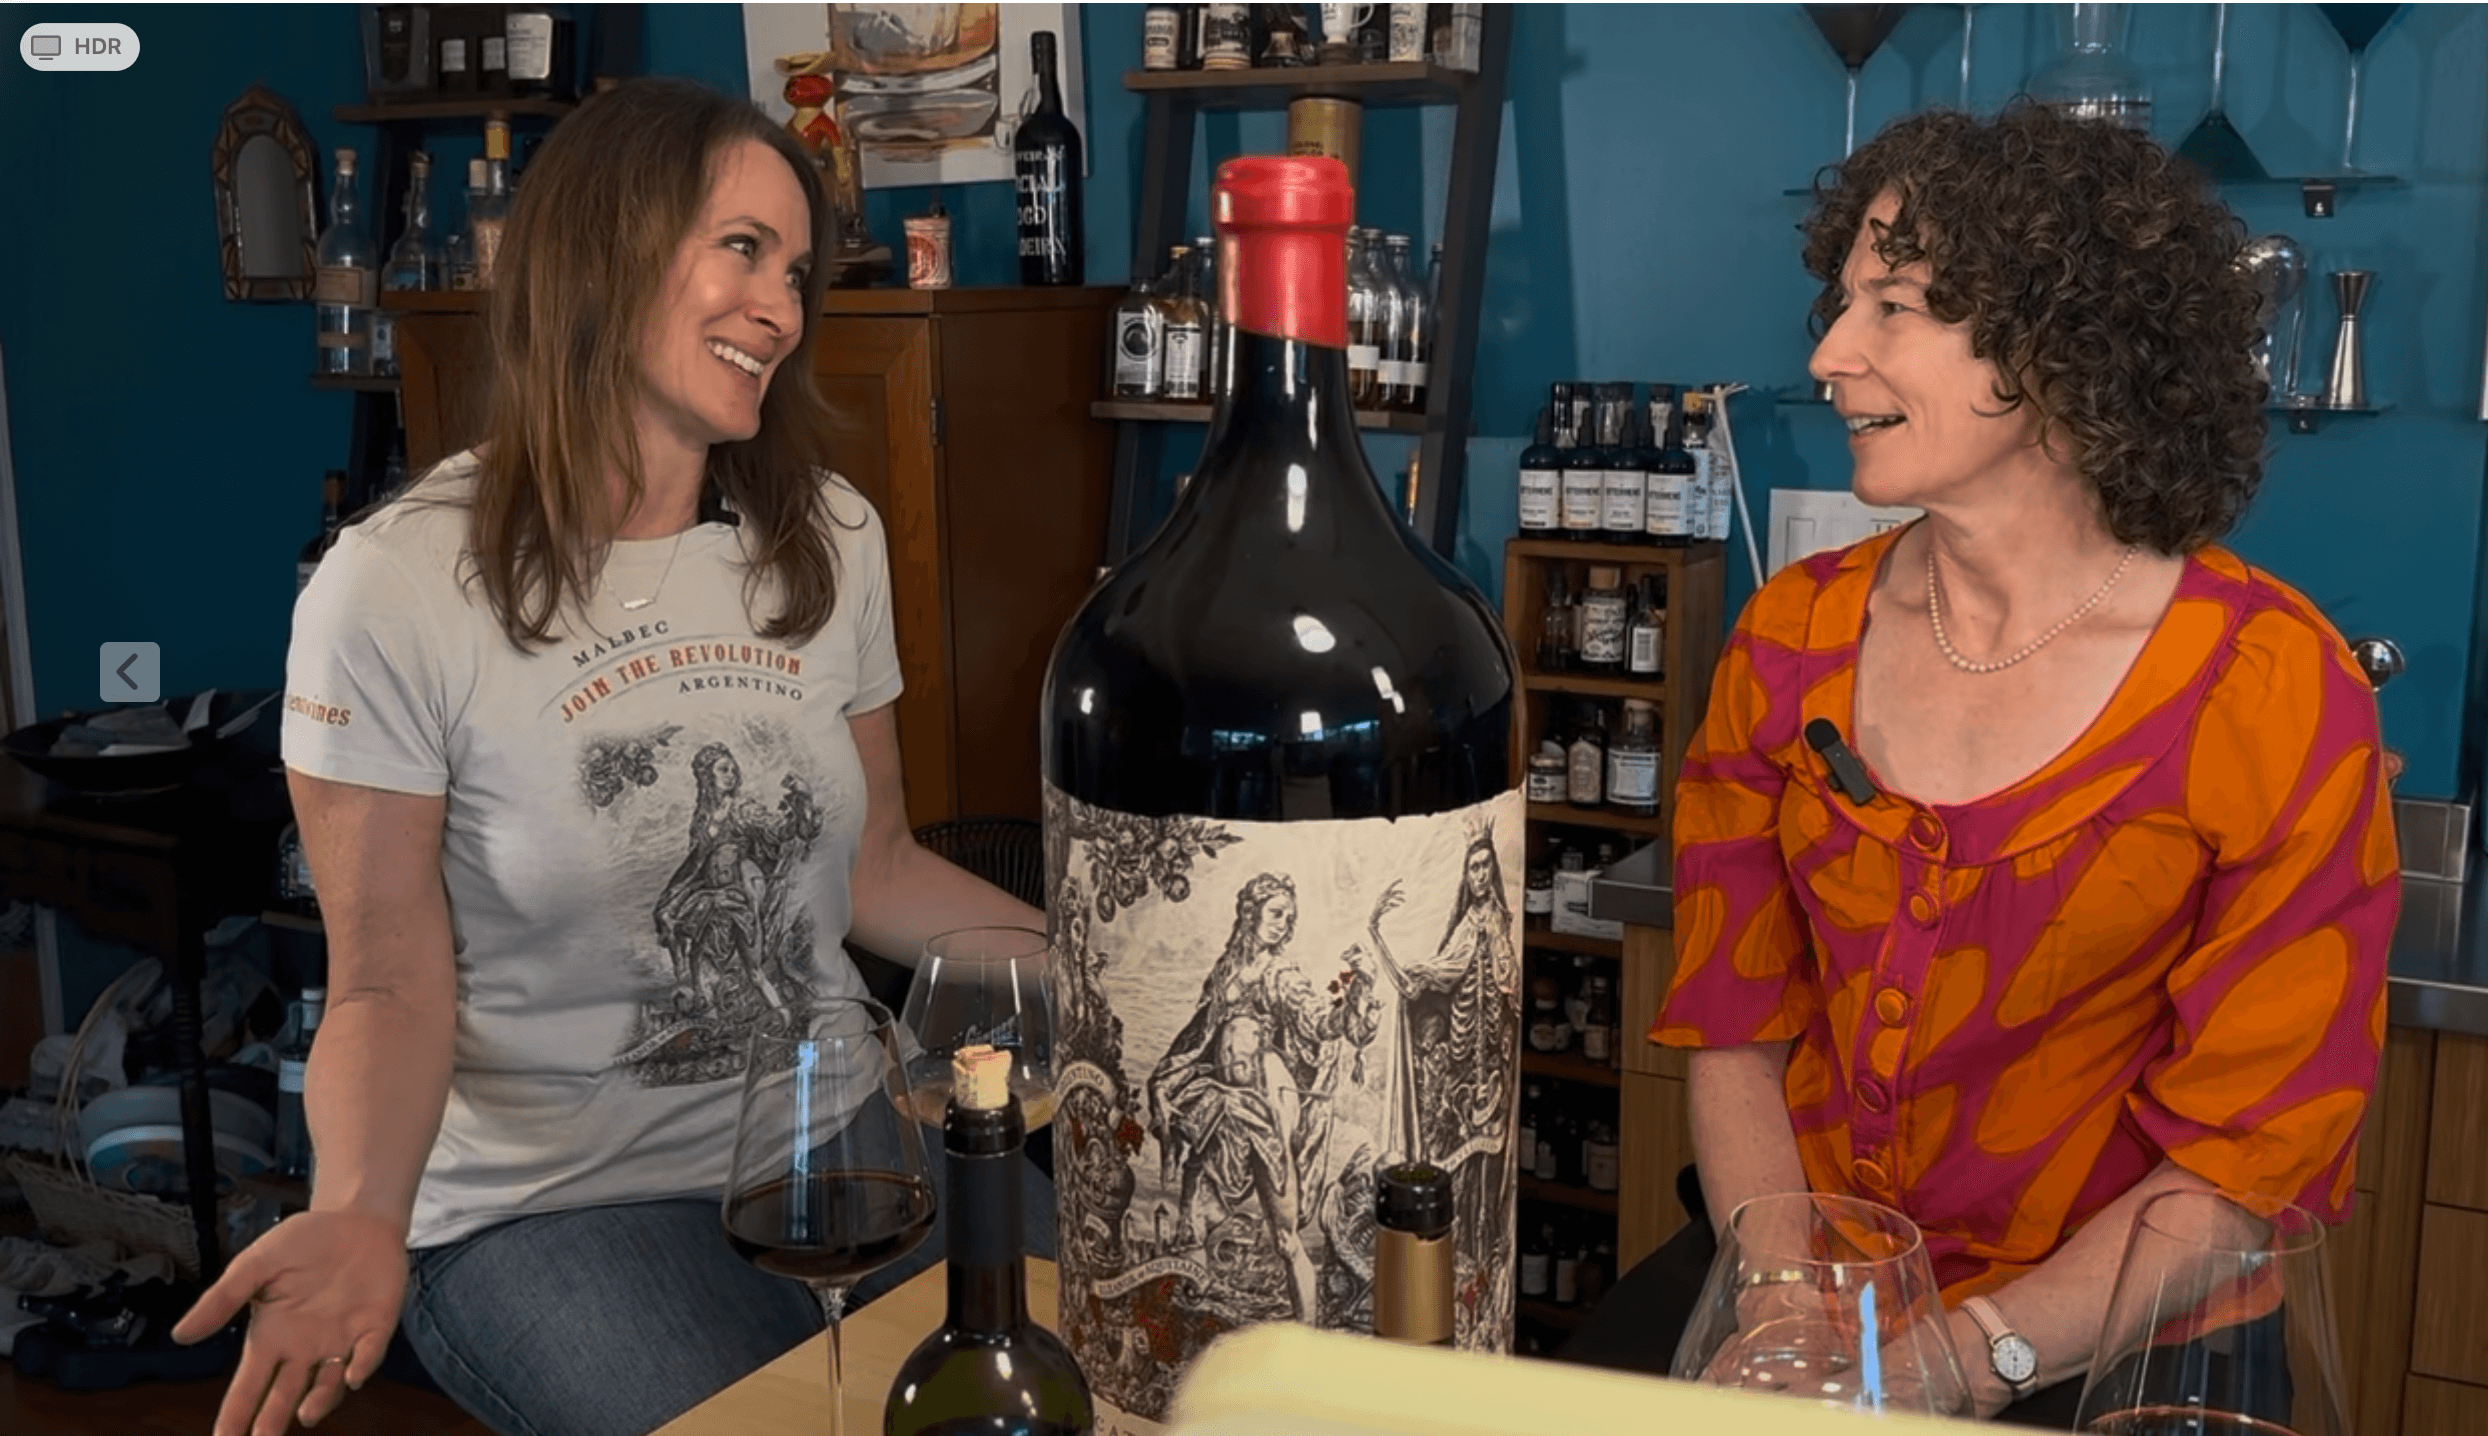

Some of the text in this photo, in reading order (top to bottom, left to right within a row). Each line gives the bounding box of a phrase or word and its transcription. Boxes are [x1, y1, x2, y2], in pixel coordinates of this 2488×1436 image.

[571, 619, 669, 668] MALBEC
[560, 643, 801, 723] JOIN THE REVOLUTION
[678, 675, 803, 701] ARGENTINO
